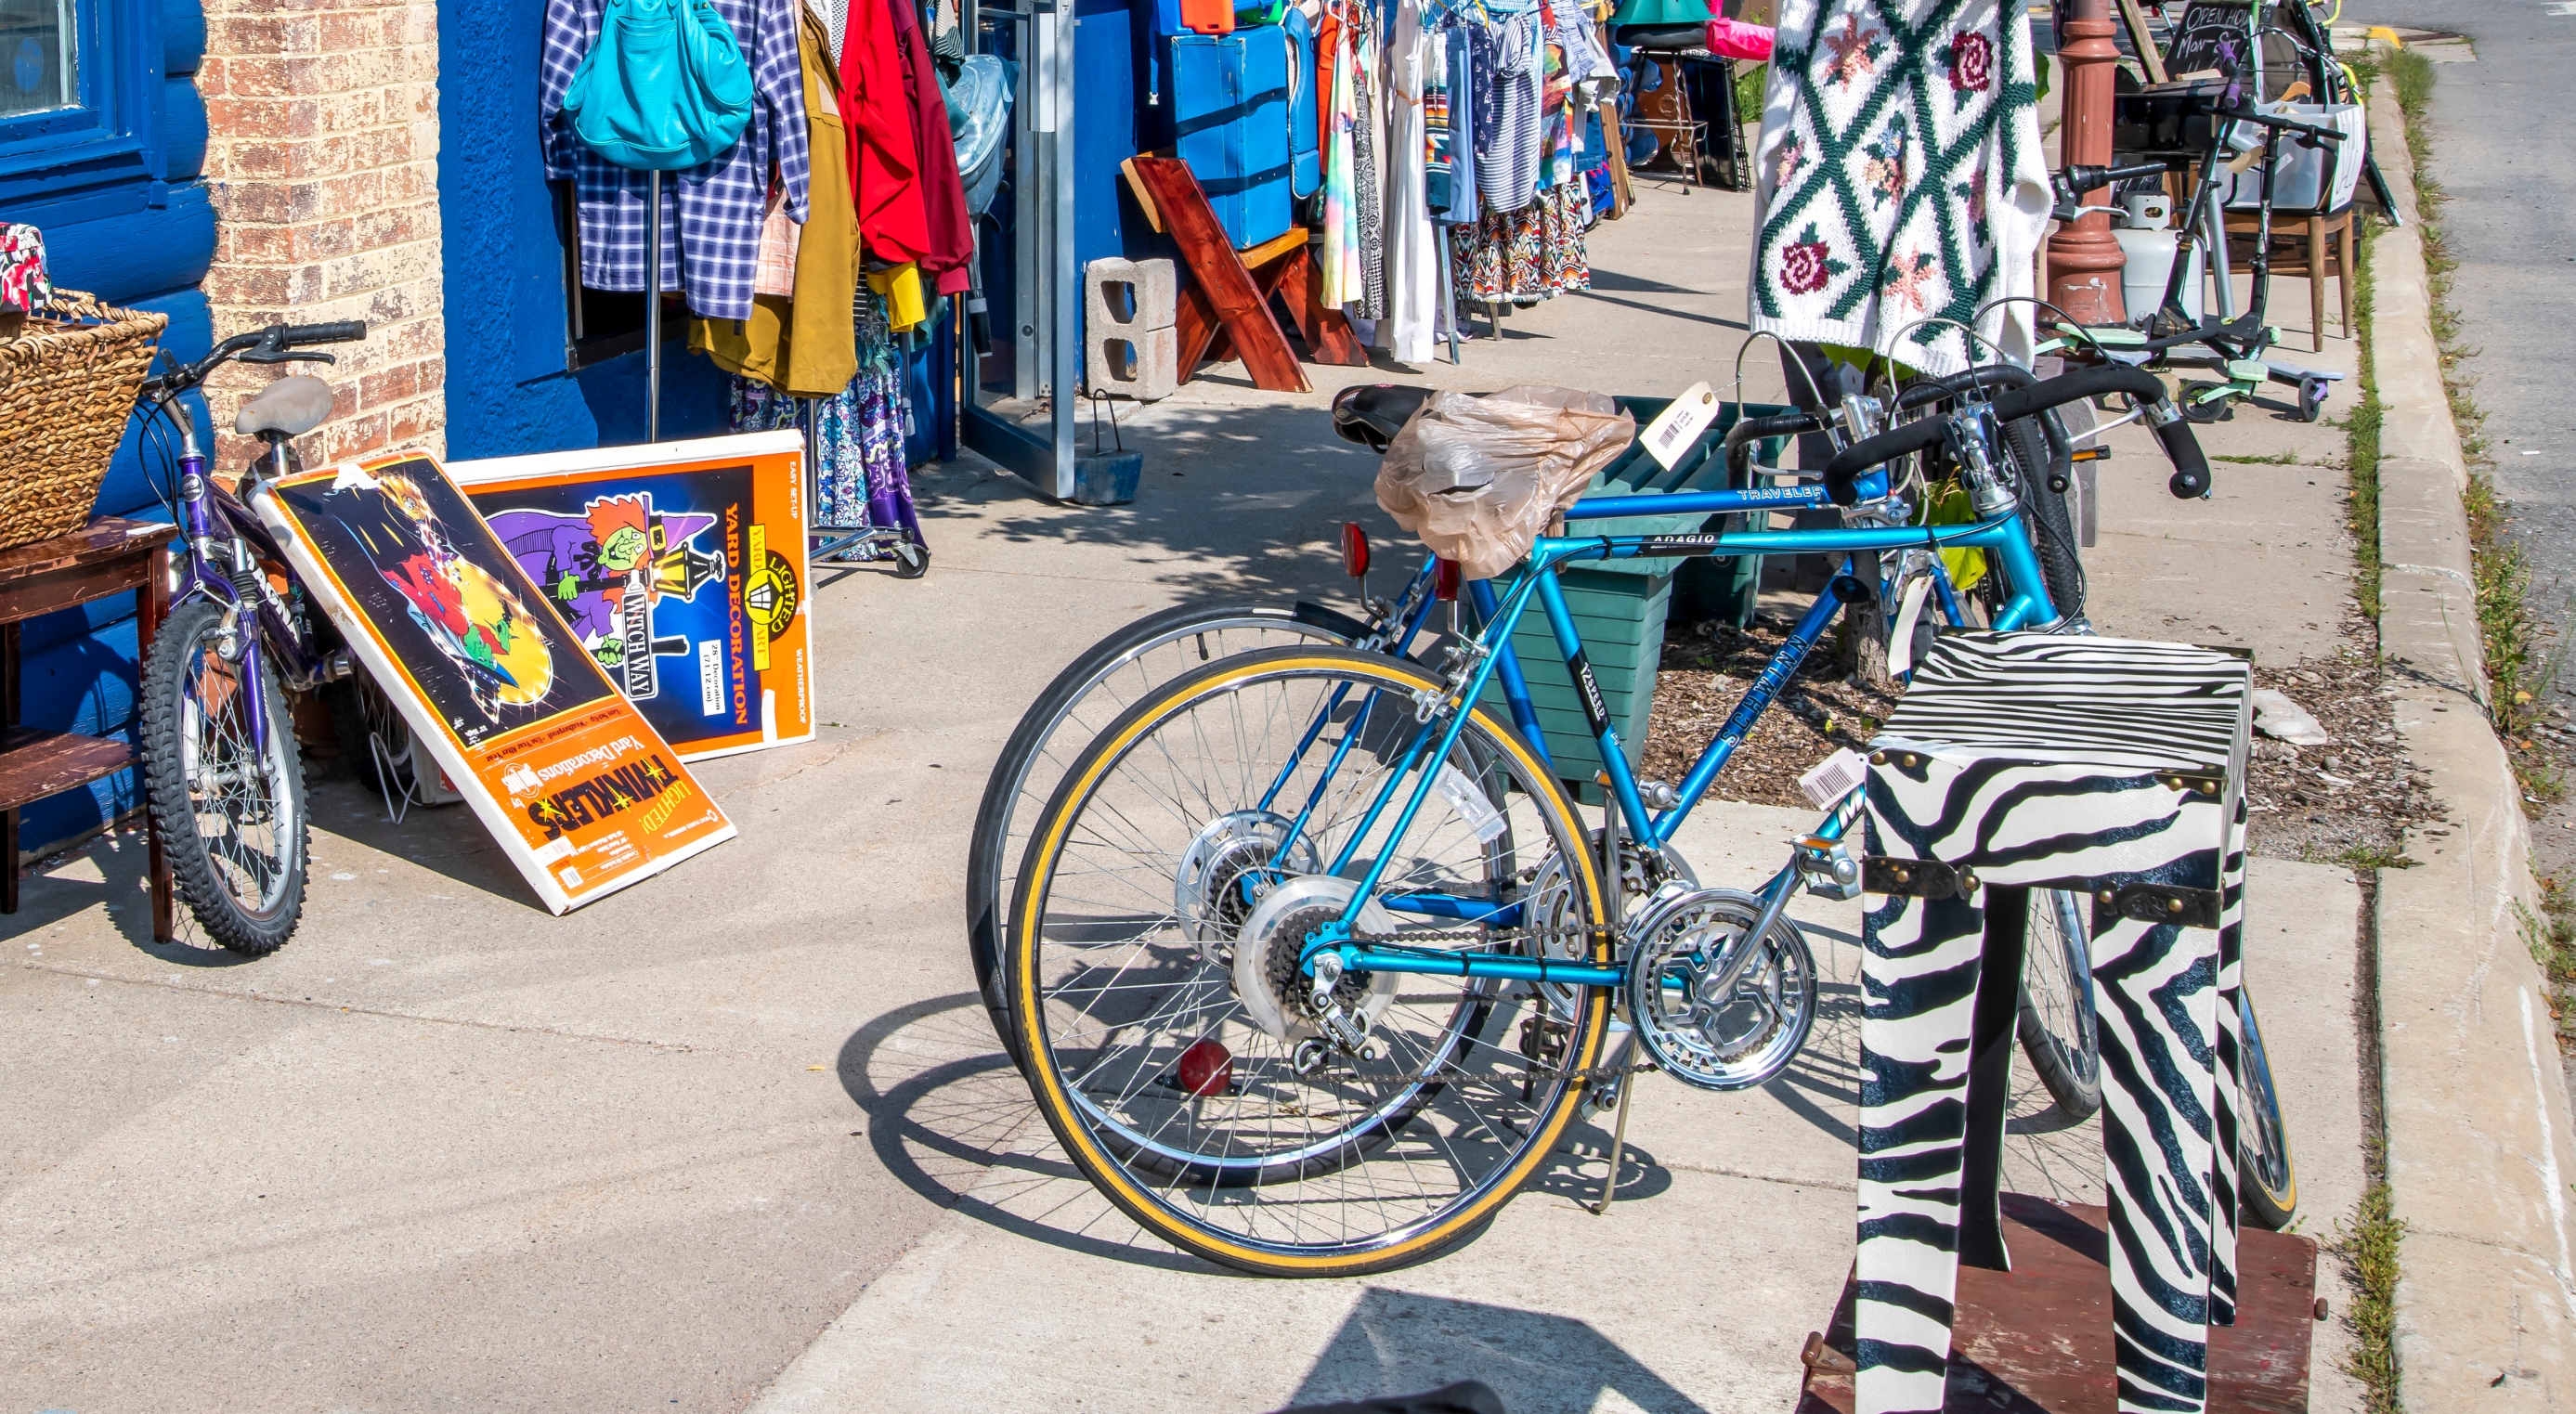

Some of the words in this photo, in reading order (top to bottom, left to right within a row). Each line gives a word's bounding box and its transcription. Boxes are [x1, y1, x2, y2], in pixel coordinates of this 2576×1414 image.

[2186, 6, 2225, 30] OPEN
[2226, 8, 2251, 26] HOU
[1737, 486, 1823, 500] TRAVELER
[726, 502, 740, 568] YARD
[753, 528, 764, 568] YARD
[1654, 534, 1715, 544] ADAGIO
[769, 557, 795, 633] LIGHTED
[625, 596, 645, 655] WITCH
[728, 573, 748, 725] DECORATION
[629, 655, 650, 692] WAY
[712, 663, 721, 710] Decoration
[796, 648, 806, 724] WEATHERPROOF
[1581, 662, 1592, 684] 12
[1588, 678, 1605, 718] SPEED
[1719, 635, 1809, 747] SCHWINN
[518, 741, 533, 750] Year
[547, 720, 585, 740] Weatherproof
[611, 734, 645, 759] Yard
[486, 751, 503, 762] Year
[502, 746, 517, 756] After
[537, 747, 616, 781] Decorations
[510, 797, 526, 809] by
[527, 754, 680, 841] TWINKLERS
[638, 780, 692, 835] LIGHTED!
